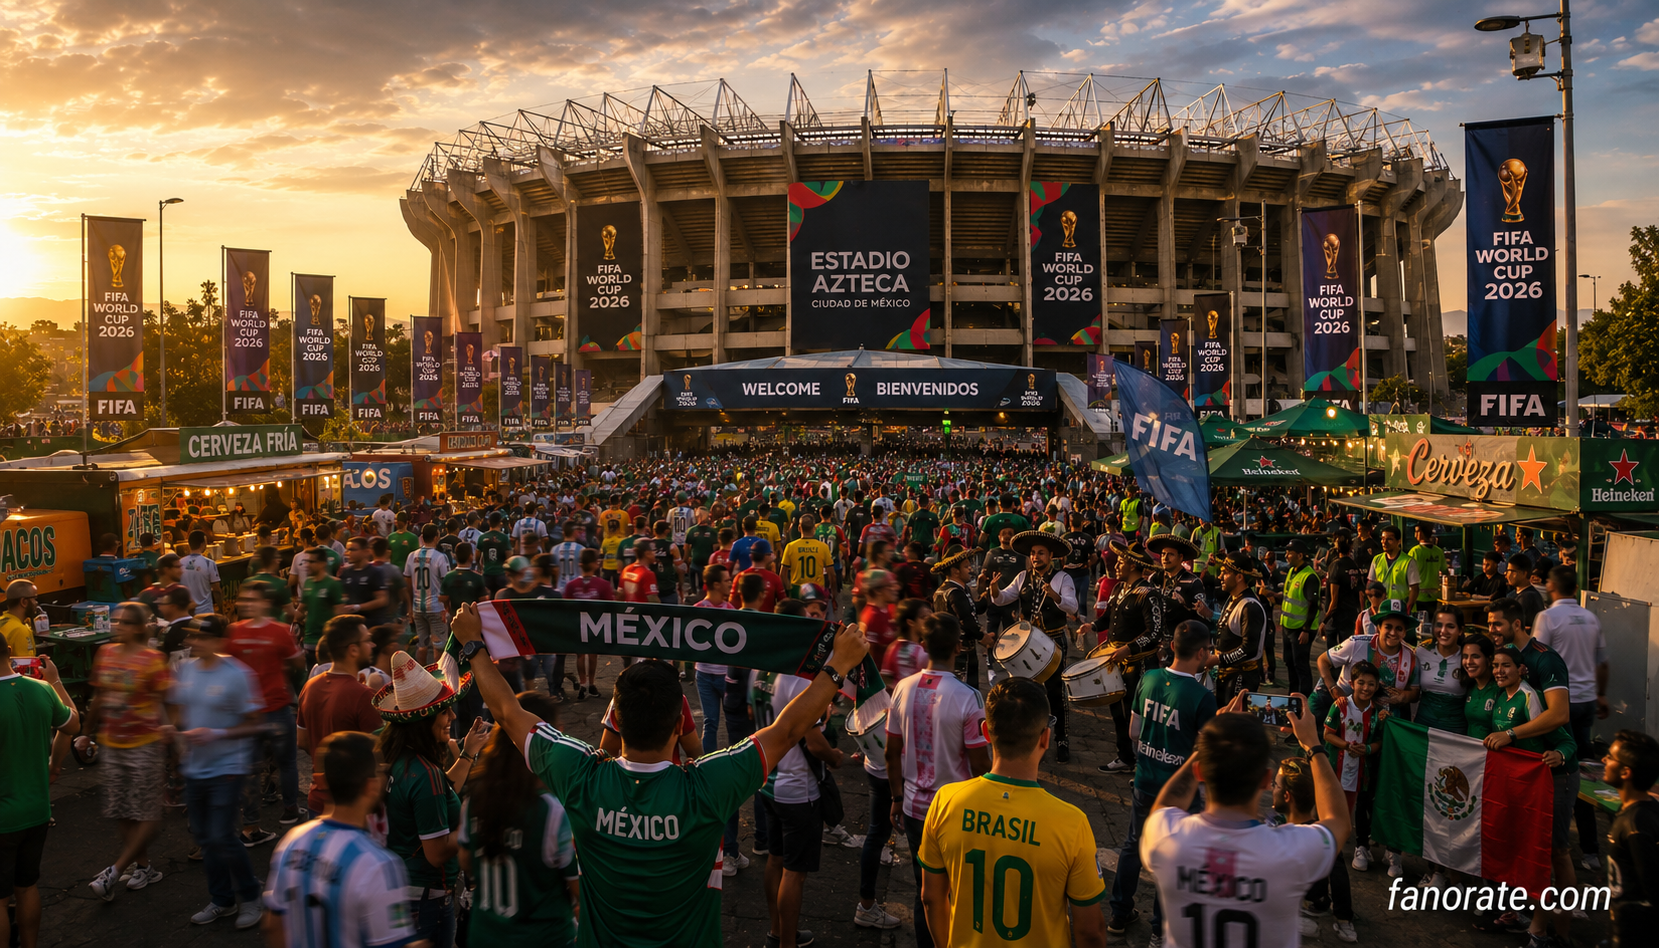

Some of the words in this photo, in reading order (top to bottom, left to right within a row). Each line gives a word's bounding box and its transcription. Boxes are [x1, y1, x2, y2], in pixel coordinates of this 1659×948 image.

[1493, 231, 1534, 246] FIFA
[811, 251, 911, 271] ESTADIO
[1055, 252, 1083, 263] FIFA
[1475, 248, 1549, 265] WORLD
[597, 264, 622, 274] FIFA
[1042, 263, 1094, 275] WORLD
[1493, 265, 1534, 280] CUP
[586, 274, 632, 285] WORLD
[811, 274, 910, 293] AZTECA
[1055, 275, 1083, 286] CUP
[597, 285, 622, 295] CUP
[1043, 287, 1093, 301] 2026
[1319, 284, 1344, 296] FIFA
[1484, 282, 1543, 300] 2026
[105, 292, 129, 302] FIFA
[589, 296, 630, 308] 2026
[811, 299, 850, 308] CIUDAD
[852, 299, 868, 308] DE
[870, 297, 911, 308] MÉXICO
[1308, 296, 1354, 308] WORLD
[93, 303, 138, 314] WORLD
[239, 310, 259, 319] FIFA
[1319, 309, 1344, 320] CUP
[105, 314, 129, 325] CUP
[230, 319, 266, 329] WORLD
[98, 326, 135, 338] 2026
[239, 328, 259, 338] CUP
[306, 329, 324, 337] FIFA
[1314, 321, 1350, 335] 2026
[234, 337, 264, 348] 2026
[298, 336, 331, 345] WORLD
[306, 344, 324, 353] CUP
[302, 352, 328, 362] 2026
[358, 364, 381, 372] 2026
[1200, 364, 1225, 372] 2026
[742, 382, 821, 396] WELCOME
[876, 382, 979, 396] BIENVENIDOS
[98, 399, 137, 415] FIFA
[233, 397, 264, 410] FIFA
[1480, 394, 1546, 417] FIFA
[302, 404, 329, 416] FIFA
[358, 408, 382, 418] FIFA
[419, 412, 440, 421] FIFA
[188, 432, 263, 458] CERVEZA
[266, 427, 298, 452] FRÍA
[1131, 411, 1198, 462] FIFA
[1403, 438, 1516, 499] Cerveza
[343, 467, 392, 489] ACOS
[1591, 487, 1656, 502] Heineken
[0, 525, 57, 574] ACOS
[797, 555, 816, 579] 10
[414, 566, 431, 590] 10
[580, 607, 748, 654] MÉXICO
[1143, 698, 1181, 731] FIFA
[596, 805, 681, 843] MÉXICO
[962, 808, 1042, 848] BRASIL
[1176, 863, 1268, 903] MÉXICO
[964, 848, 1035, 942] 10
[1181, 902, 1261, 948] 10
